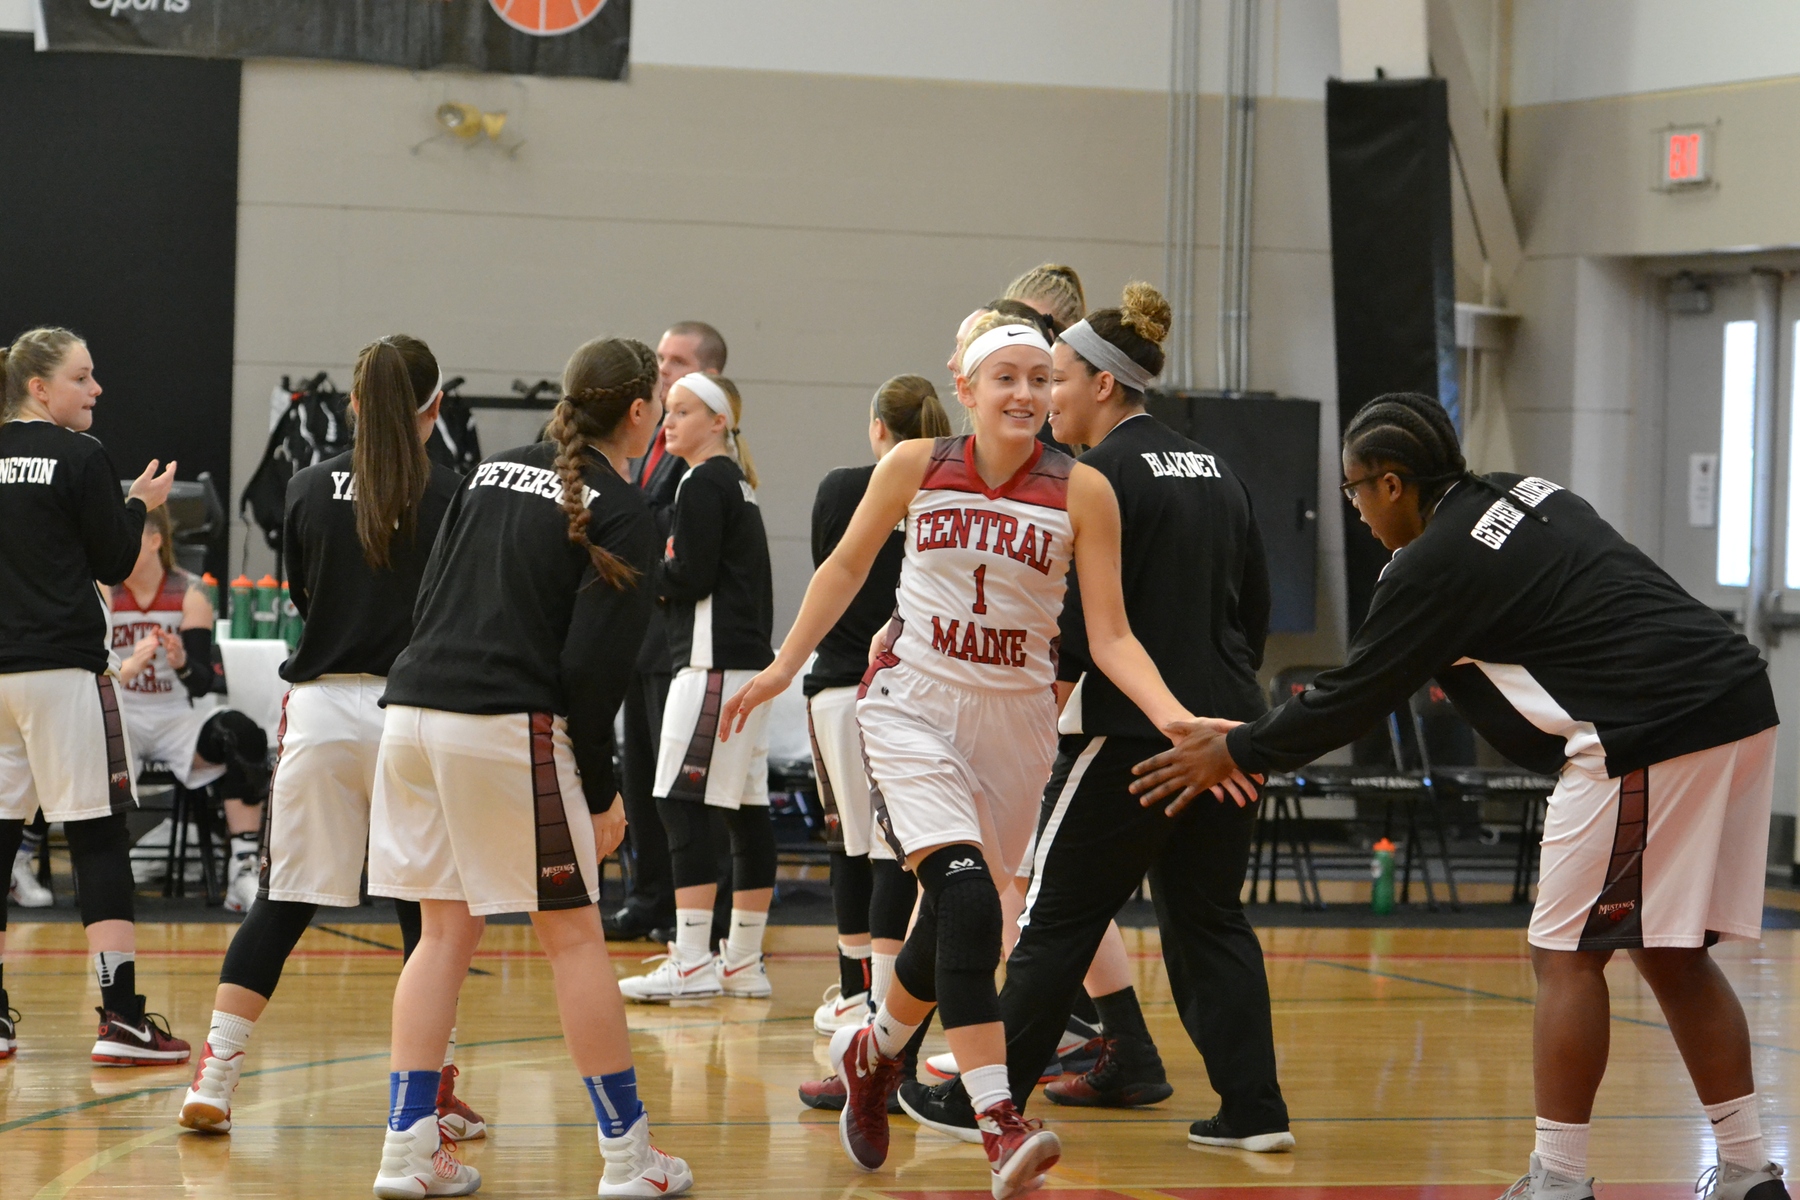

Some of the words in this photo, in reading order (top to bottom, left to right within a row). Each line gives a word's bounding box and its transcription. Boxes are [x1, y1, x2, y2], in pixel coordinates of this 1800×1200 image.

[1140, 451, 1222, 478] BLAKNEY
[916, 508, 1053, 576] CENTRAL
[973, 563, 987, 615] 1
[931, 616, 1027, 667] MAINE
[1598, 900, 1636, 915] MUSTANGS
